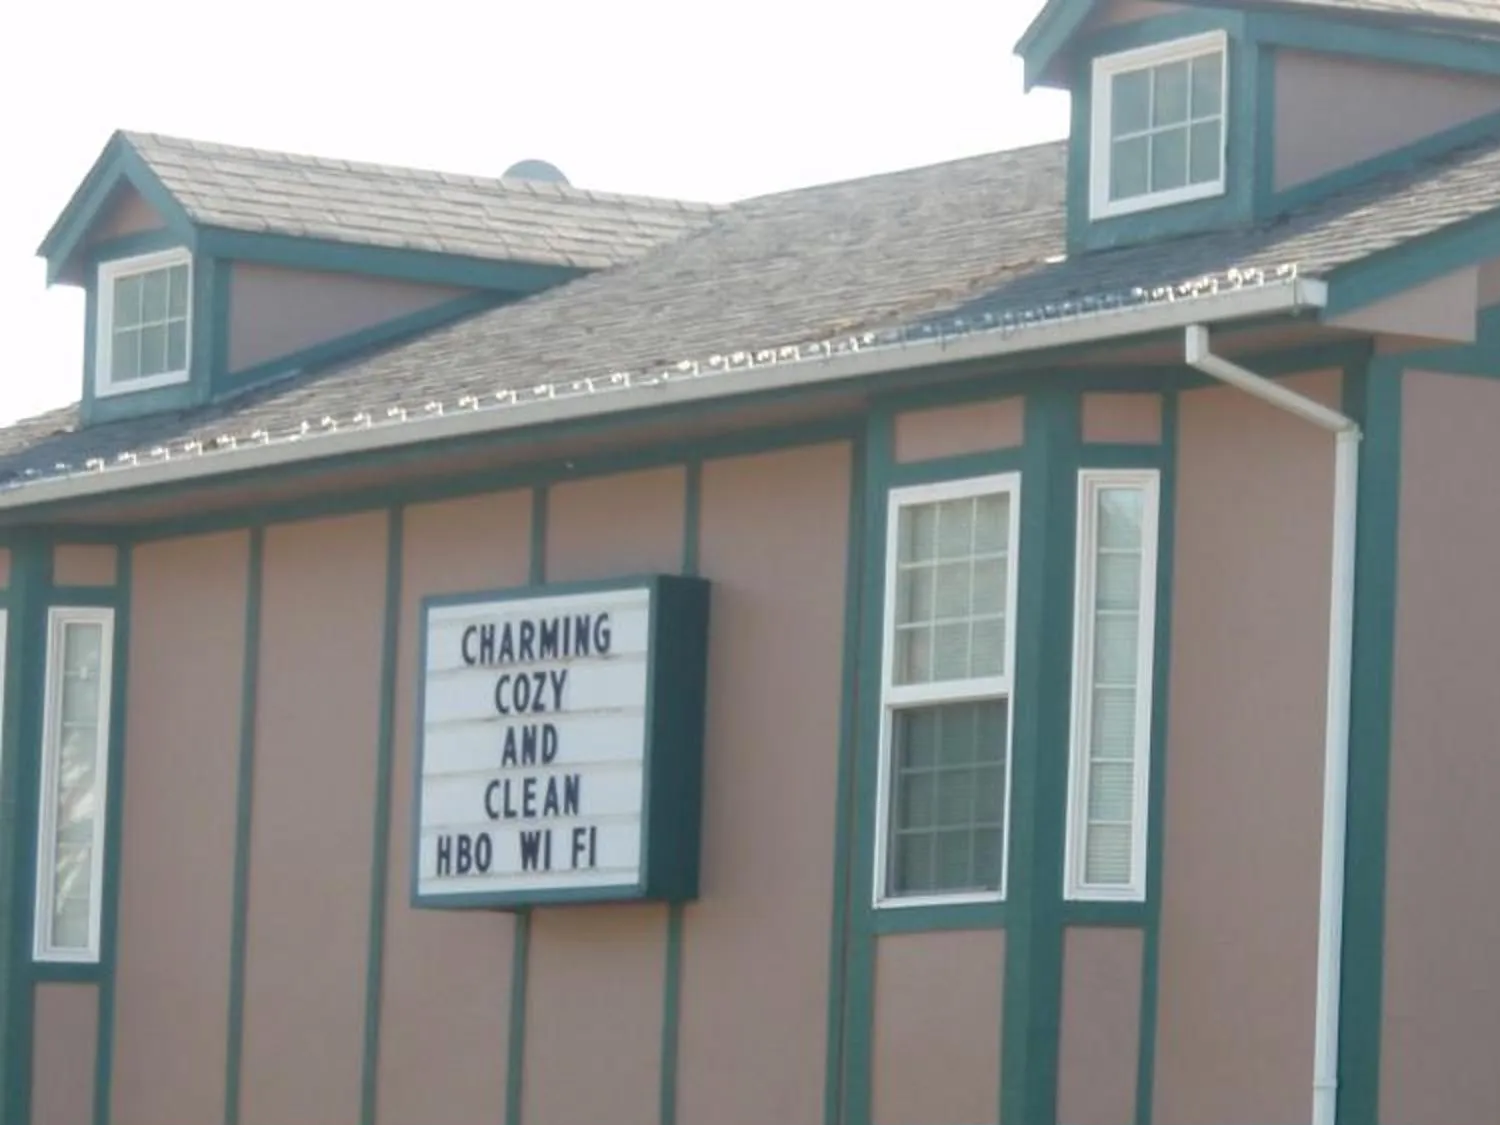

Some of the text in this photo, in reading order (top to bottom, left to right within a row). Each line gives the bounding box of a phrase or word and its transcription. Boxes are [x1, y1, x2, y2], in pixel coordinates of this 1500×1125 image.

[461, 613, 612, 665] CHARMING
[494, 669, 568, 714] COZY
[501, 724, 558, 767] AND
[484, 774, 580, 820] CLEAN
[437, 826, 597, 877] HBO WI FI
